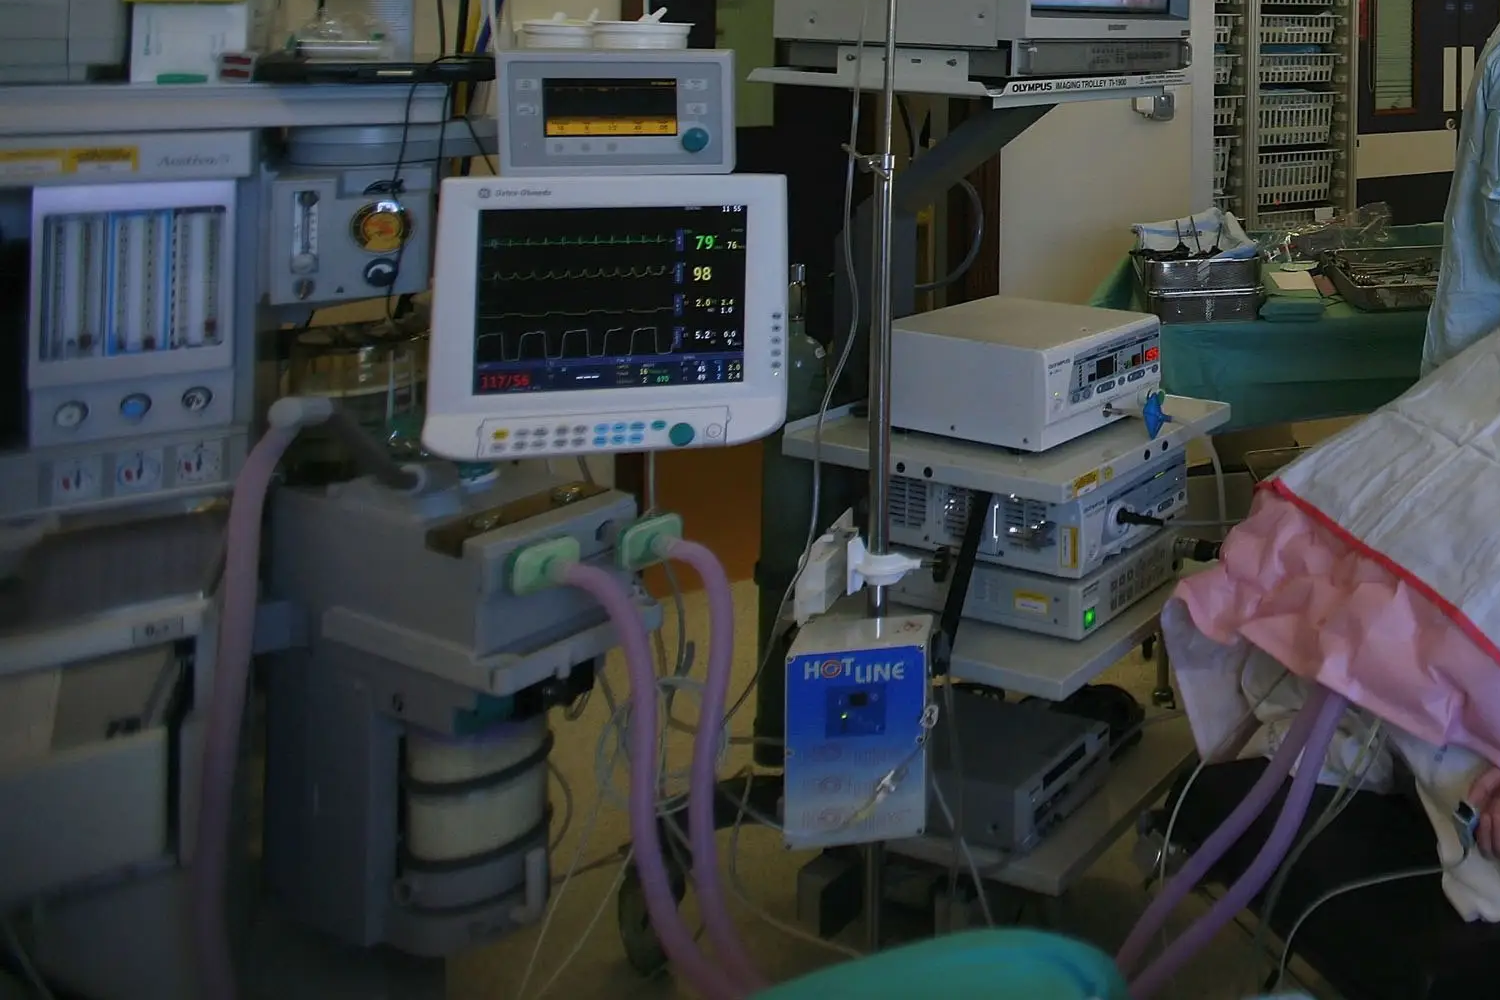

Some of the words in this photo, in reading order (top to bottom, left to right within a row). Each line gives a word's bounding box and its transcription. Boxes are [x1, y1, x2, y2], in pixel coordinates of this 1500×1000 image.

[1012, 82, 1052, 93] OLYMPUS
[1055, 80, 1081, 90] IMAGING
[1082, 79, 1107, 89] TROLLEY
[696, 235, 714, 250] 79
[693, 266, 711, 281] 98
[804, 657, 905, 684] HOTLINE
